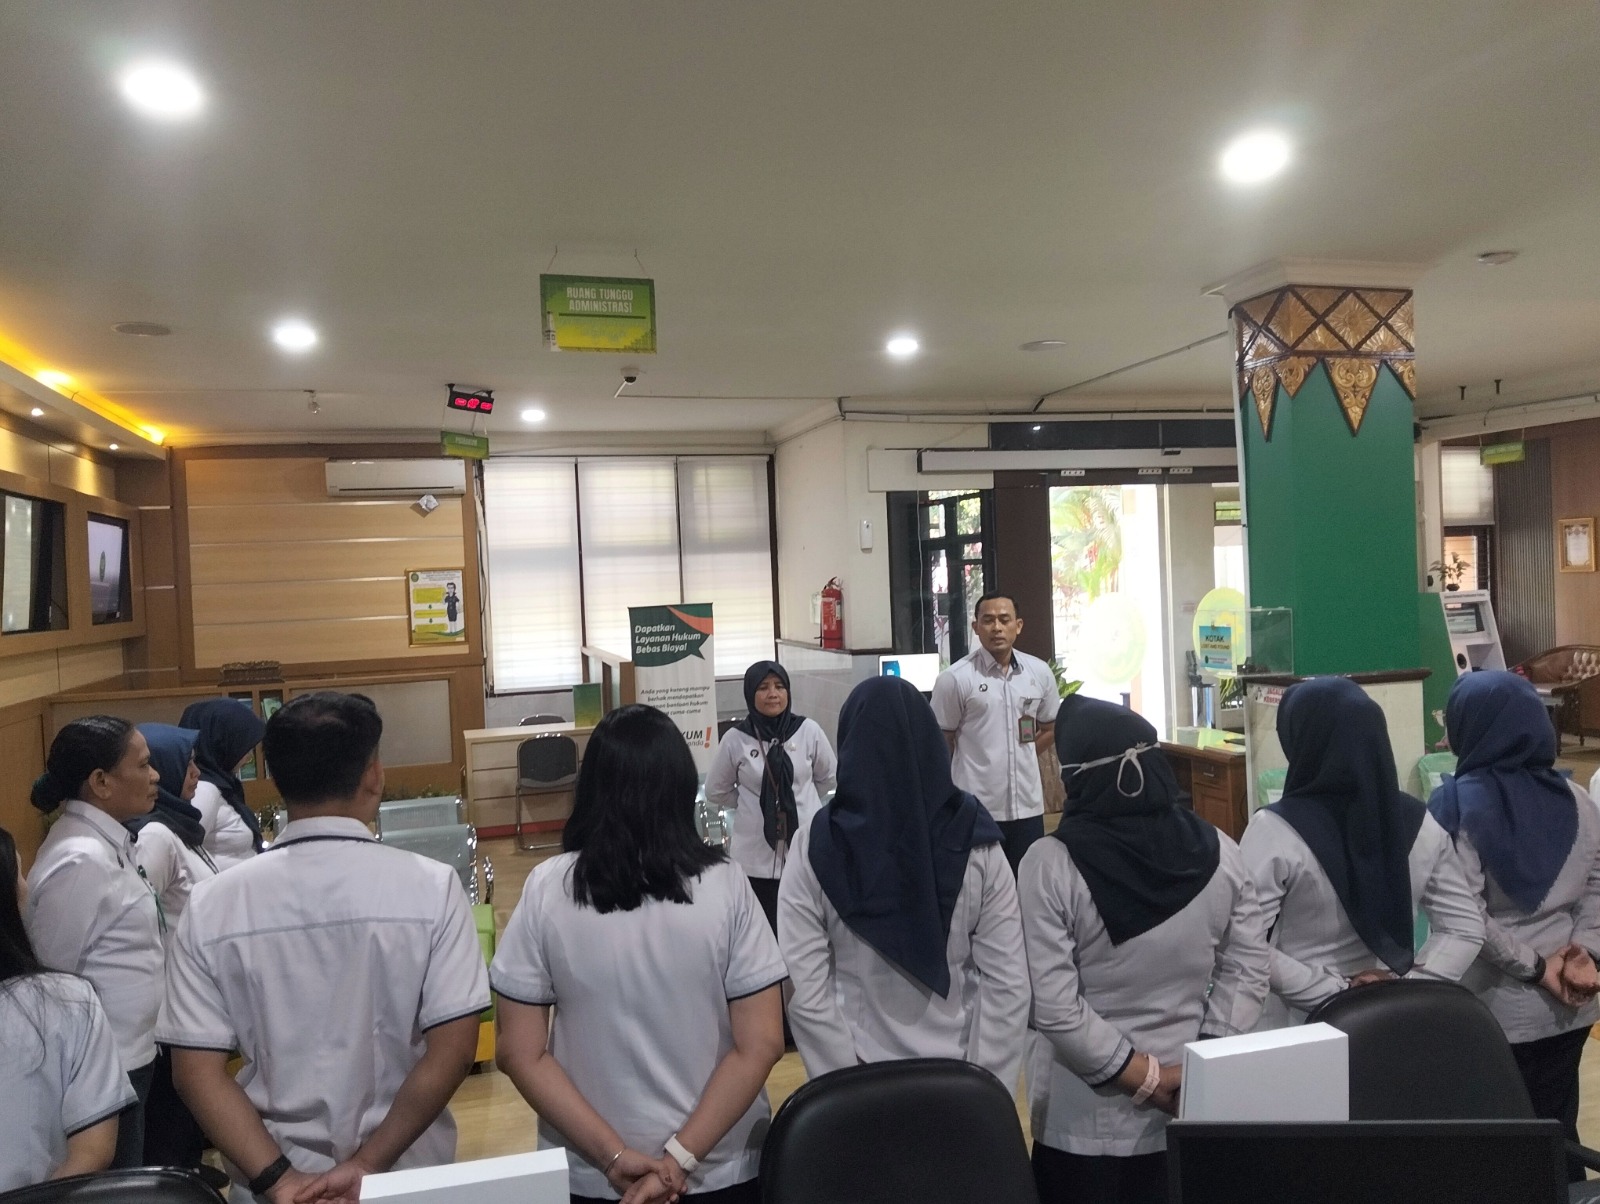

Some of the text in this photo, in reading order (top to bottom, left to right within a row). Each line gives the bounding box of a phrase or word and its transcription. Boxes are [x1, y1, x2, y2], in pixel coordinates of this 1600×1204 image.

[567, 287, 633, 300] RUANG TUNGGU
[569, 300, 632, 313] ADMINISTRASI
[635, 624, 675, 634] Dapatkan
[635, 632, 700, 644] Layanan Hukum
[636, 643, 687, 653] Bebas Biaya!
